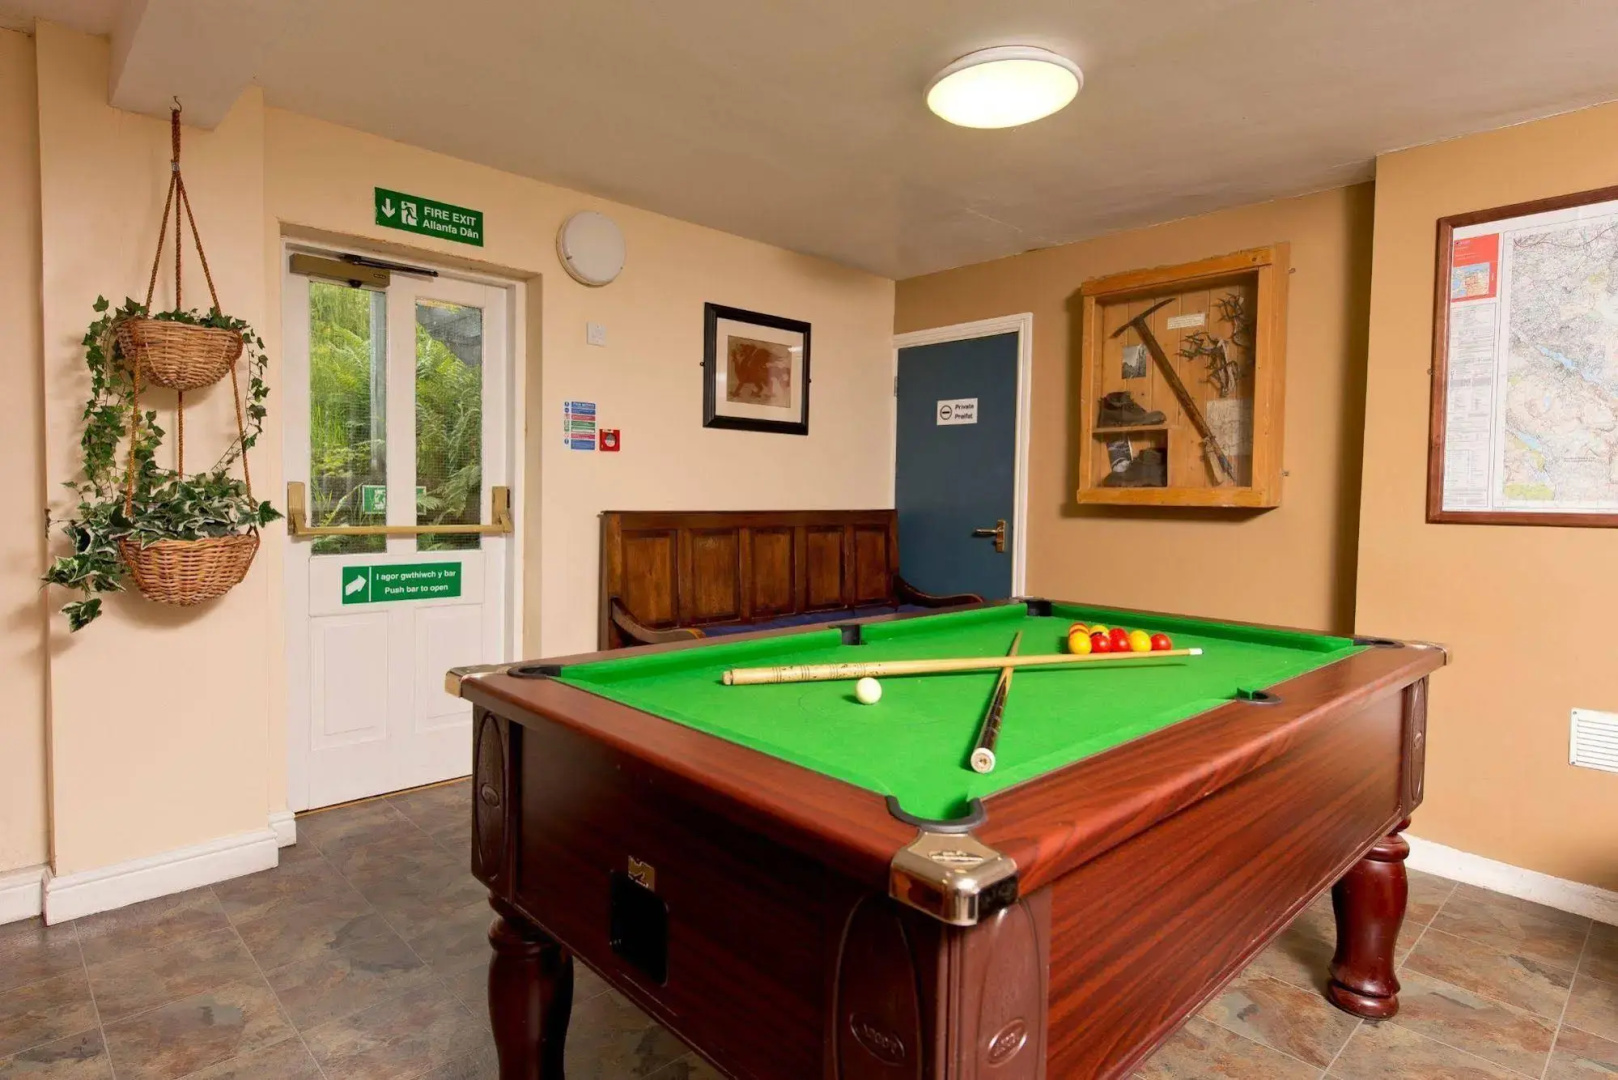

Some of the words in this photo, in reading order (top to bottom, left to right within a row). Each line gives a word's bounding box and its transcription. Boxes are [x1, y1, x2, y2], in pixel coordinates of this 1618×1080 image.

[424, 206, 449, 220] FIRE
[452, 213, 476, 226] EXIT
[423, 219, 457, 234] Allanfa
[460, 227, 479, 239] Dân
[381, 573, 399, 582] agor
[400, 570, 436, 581] gwthiwch
[438, 571, 443, 579] y
[444, 569, 456, 577] bar
[384, 586, 405, 595] Push
[406, 585, 419, 593] bar
[421, 584, 429, 592] to
[430, 584, 449, 593] open
